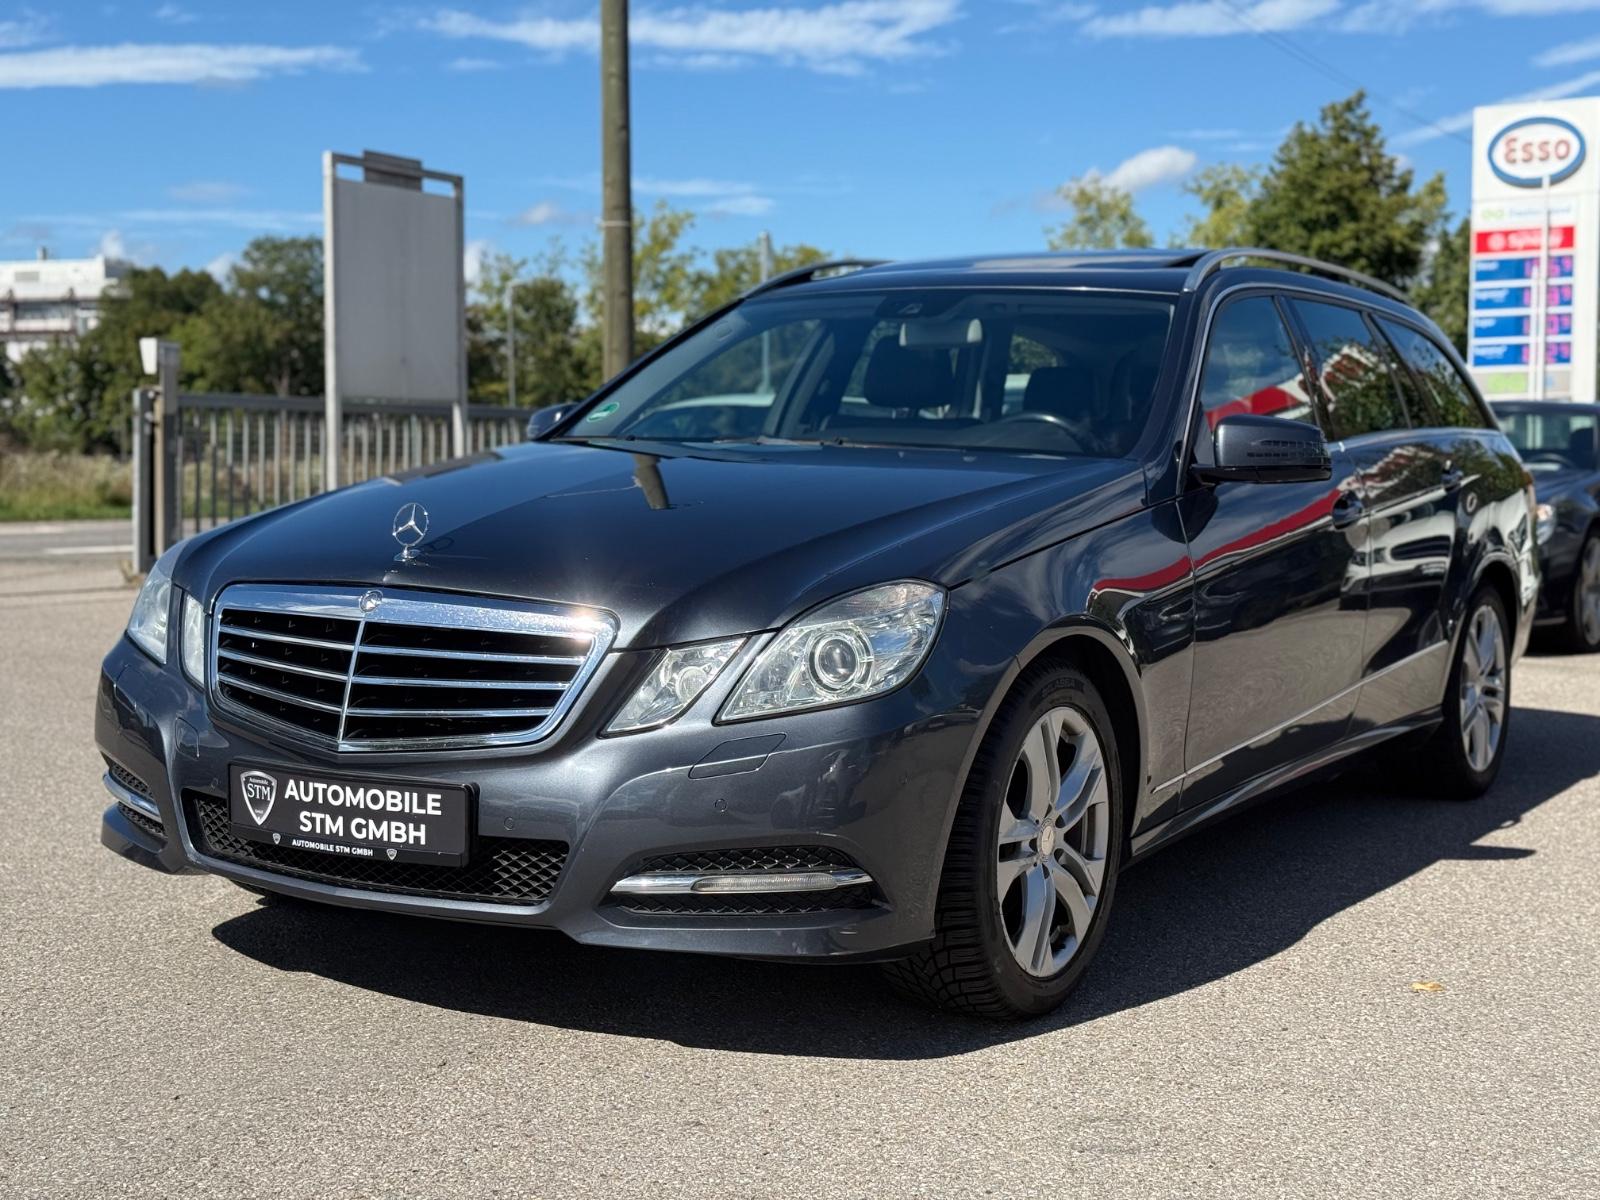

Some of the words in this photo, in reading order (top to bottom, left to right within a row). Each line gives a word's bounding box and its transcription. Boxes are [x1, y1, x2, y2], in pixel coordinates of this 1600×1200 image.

[247, 783, 271, 801] STM
[284, 779, 442, 816] AUTOMOBILE
[299, 811, 343, 837] STM
[350, 818, 426, 845] GMBH
[292, 839, 334, 852] AUTOMOBILE
[336, 845, 350, 854] STM
[351, 847, 373, 856] GMBH
